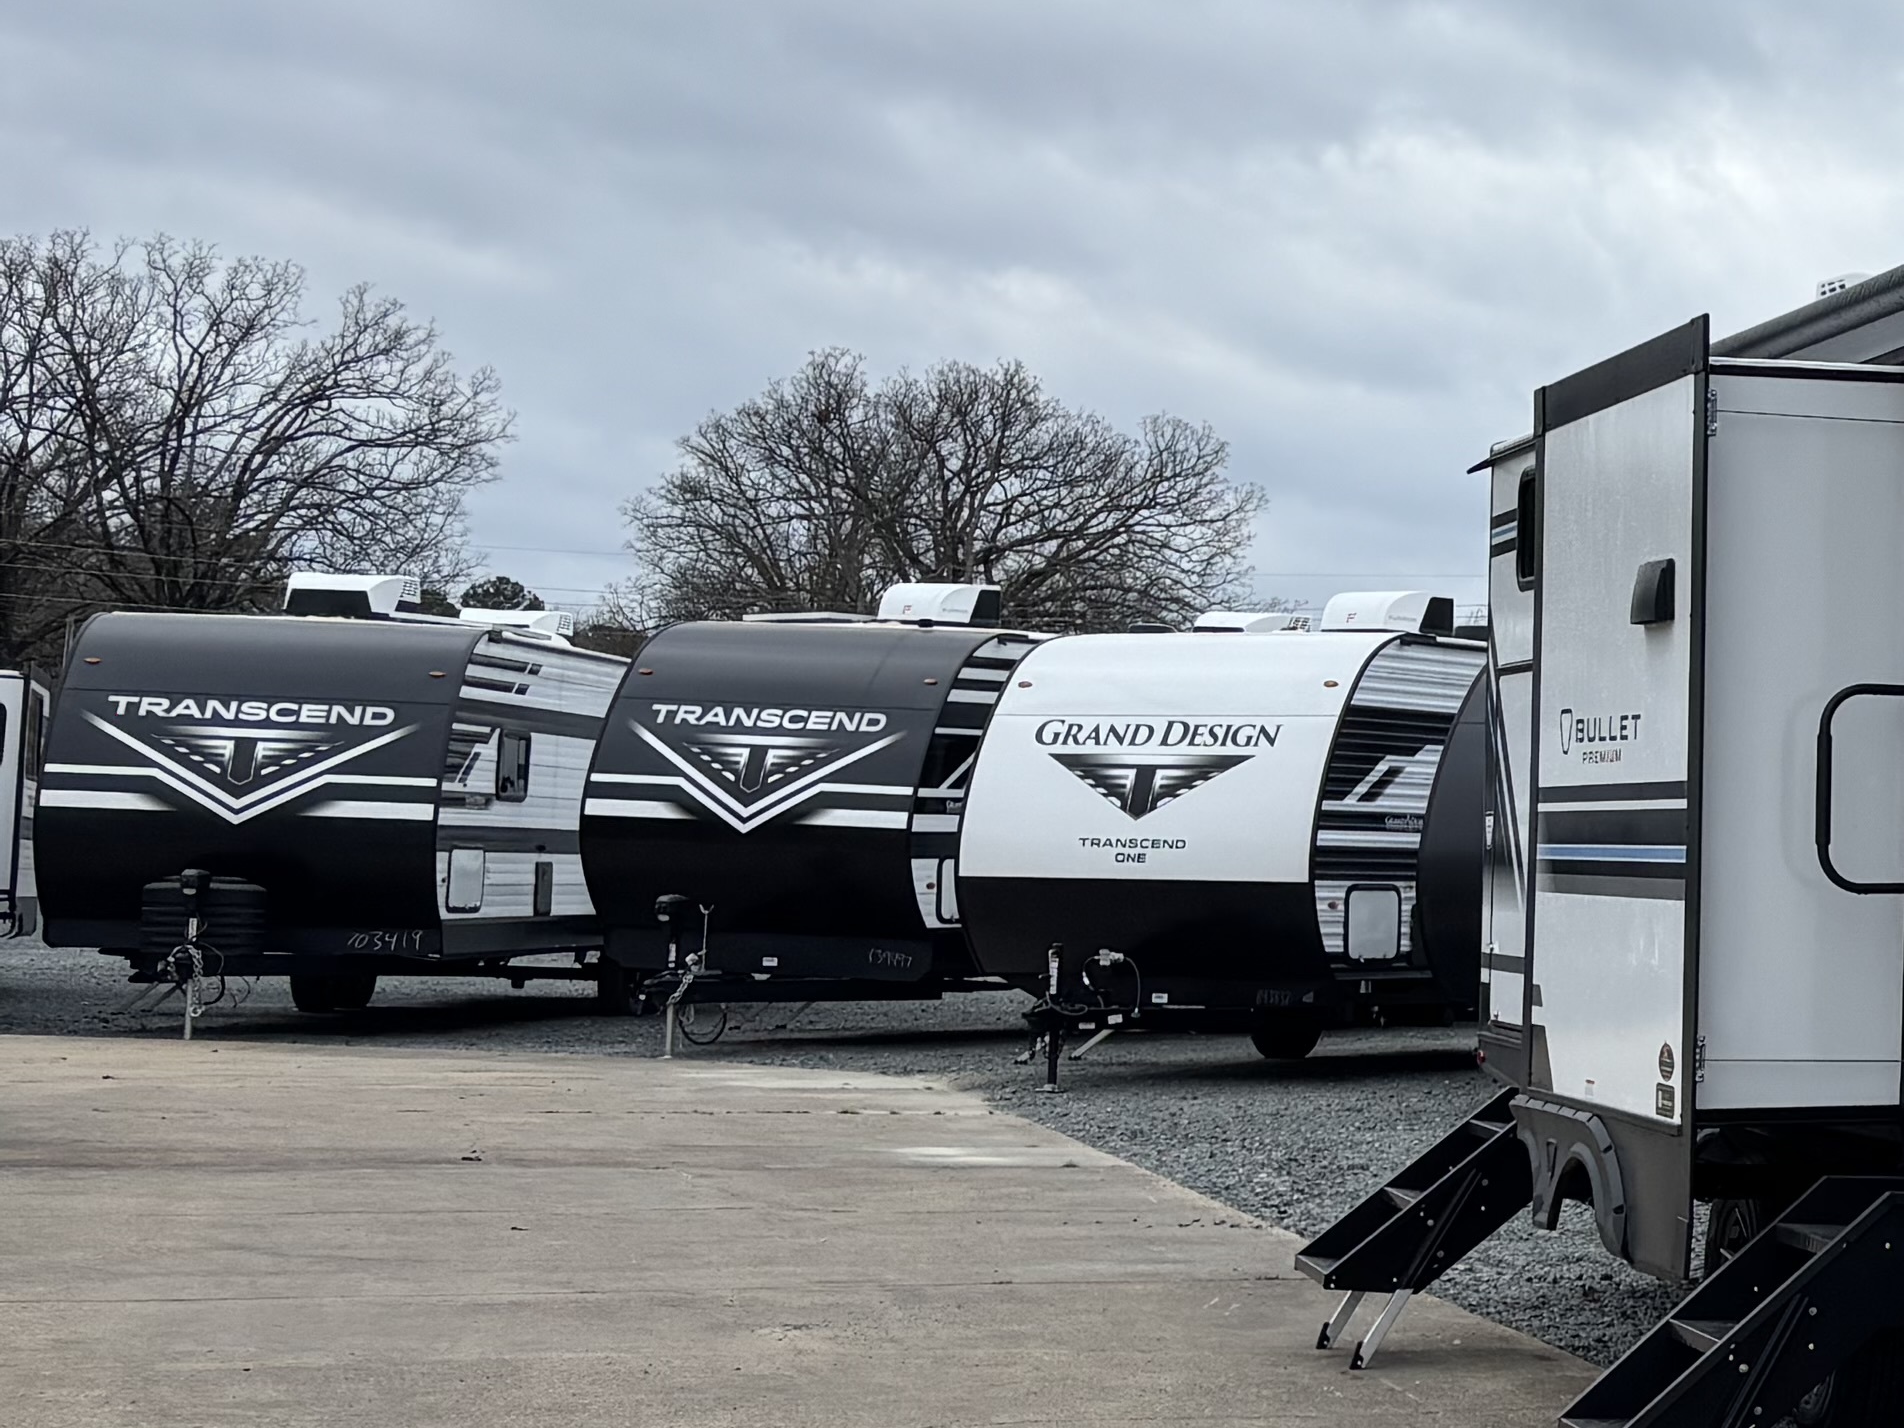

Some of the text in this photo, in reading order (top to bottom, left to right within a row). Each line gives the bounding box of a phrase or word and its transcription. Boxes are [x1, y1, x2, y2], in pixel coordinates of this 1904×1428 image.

[107, 695, 395, 726] TRANSCEND
[651, 703, 888, 733] TRANSCEND
[1034, 719, 1285, 748] GRAND DESIGN
[1575, 714, 1642, 744] BULLET
[1079, 837, 1188, 850] TRANSCEND
[1114, 852, 1147, 864] ONE
